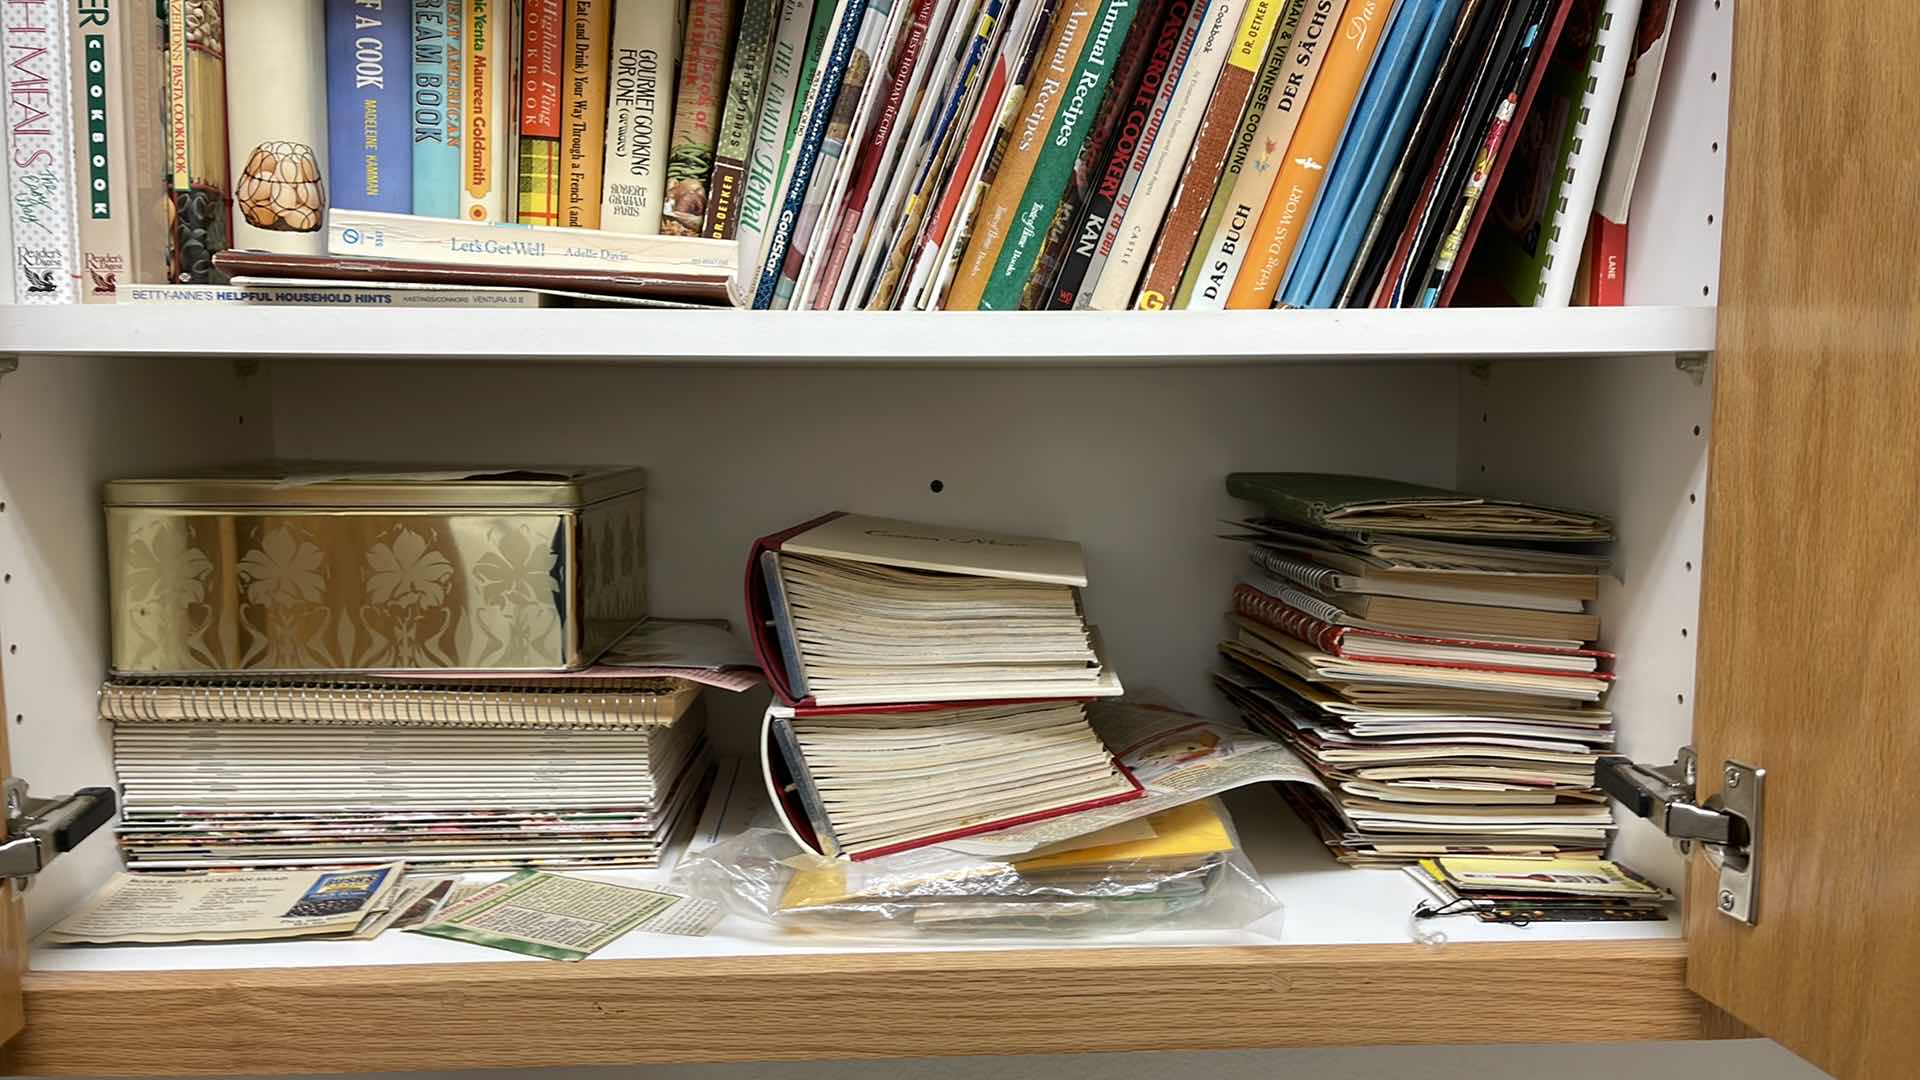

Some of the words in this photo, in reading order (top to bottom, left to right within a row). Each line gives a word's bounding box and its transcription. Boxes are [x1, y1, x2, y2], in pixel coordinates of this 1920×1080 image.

[355, 15, 382, 29] A
[575, 17, 590, 40] (and
[576, 1, 591, 16] Eat
[1204, 5, 1229, 54] Cookbook
[1286, 0, 1304, 28] MAN
[1346, 1, 1376, 52] Das
[473, 15, 487, 51] Yenta
[541, 0, 560, 76] Highland
[908, 31, 922, 55] BEST
[1051, 10, 1088, 73] Annual
[1088, 0, 1129, 66] Annual
[1135, 1, 1188, 106] CASSEROLE
[1280, 32, 1292, 40] &
[355, 37, 384, 89] COOK
[574, 43, 590, 74] Drink)
[617, 48, 638, 75] FOR
[635, 49, 658, 115] GOURMET
[772, 41, 794, 78] THE
[888, 56, 912, 104] HOLIDAY
[1254, 44, 1288, 112] VIENNESE
[173, 65, 183, 100] PASTA
[447, 44, 462, 149] AMERICAN
[473, 55, 486, 114] Maureen
[537, 80, 557, 127] Fling
[572, 76, 589, 102] Your
[615, 76, 636, 107] ONE
[730, 44, 759, 147] SCHULKOCHBUC
[9, 45, 54, 168] MEALS
[88, 39, 108, 214] COOKBOOK
[364, 99, 378, 150] MADELEINE
[415, 72, 443, 144] BOOK
[570, 101, 587, 120] Way
[760, 82, 786, 148] FAMILY
[875, 104, 896, 146] RECIPES
[1019, 77, 1062, 151] Recipes
[1056, 69, 1102, 147] Recipes
[174, 104, 186, 173] COOKBOOK
[473, 117, 486, 185] Goldsmith
[569, 122, 586, 160] Through
[630, 115, 653, 177] COOKING
[1099, 110, 1145, 202] COOKERY
[1132, 107, 1163, 172] COOKING
[1203, 260, 1228, 300] DAS
[1221, 203, 1251, 256] BUCH
[1277, 72, 1305, 113] DER
[1296, 0, 1332, 67] SÄCHS
[1230, 114, 1261, 175] COOKING
[568, 170, 584, 203] French
[608, 195, 647, 208] GRAHAM
[610, 183, 647, 196] ROBERT
[740, 148, 774, 233] Herbal
[568, 206, 583, 228] (and
[1076, 214, 1106, 257] KAN
[1253, 254, 1280, 292] Verlag
[1268, 226, 1288, 255] DAS
[1280, 184, 1304, 225] WORT
[17, 246, 62, 266] Reader's
[35, 256, 62, 267] Digest
[85, 252, 123, 269] Reader's
[451, 237, 483, 253] Let's
[485, 239, 511, 255] Get
[513, 241, 545, 256] Well
[766, 209, 794, 277] GoldStar
[1002, 249, 1024, 278] Books
[1121, 225, 1142, 264] CASTLE
[1608, 256, 1617, 280] LANE
[132, 290, 214, 301] BETTY-ANNE'S
[216, 291, 273, 302] HELPFUL
[275, 292, 352, 303] HOUSEHOLD
[355, 294, 392, 304] HINTS
